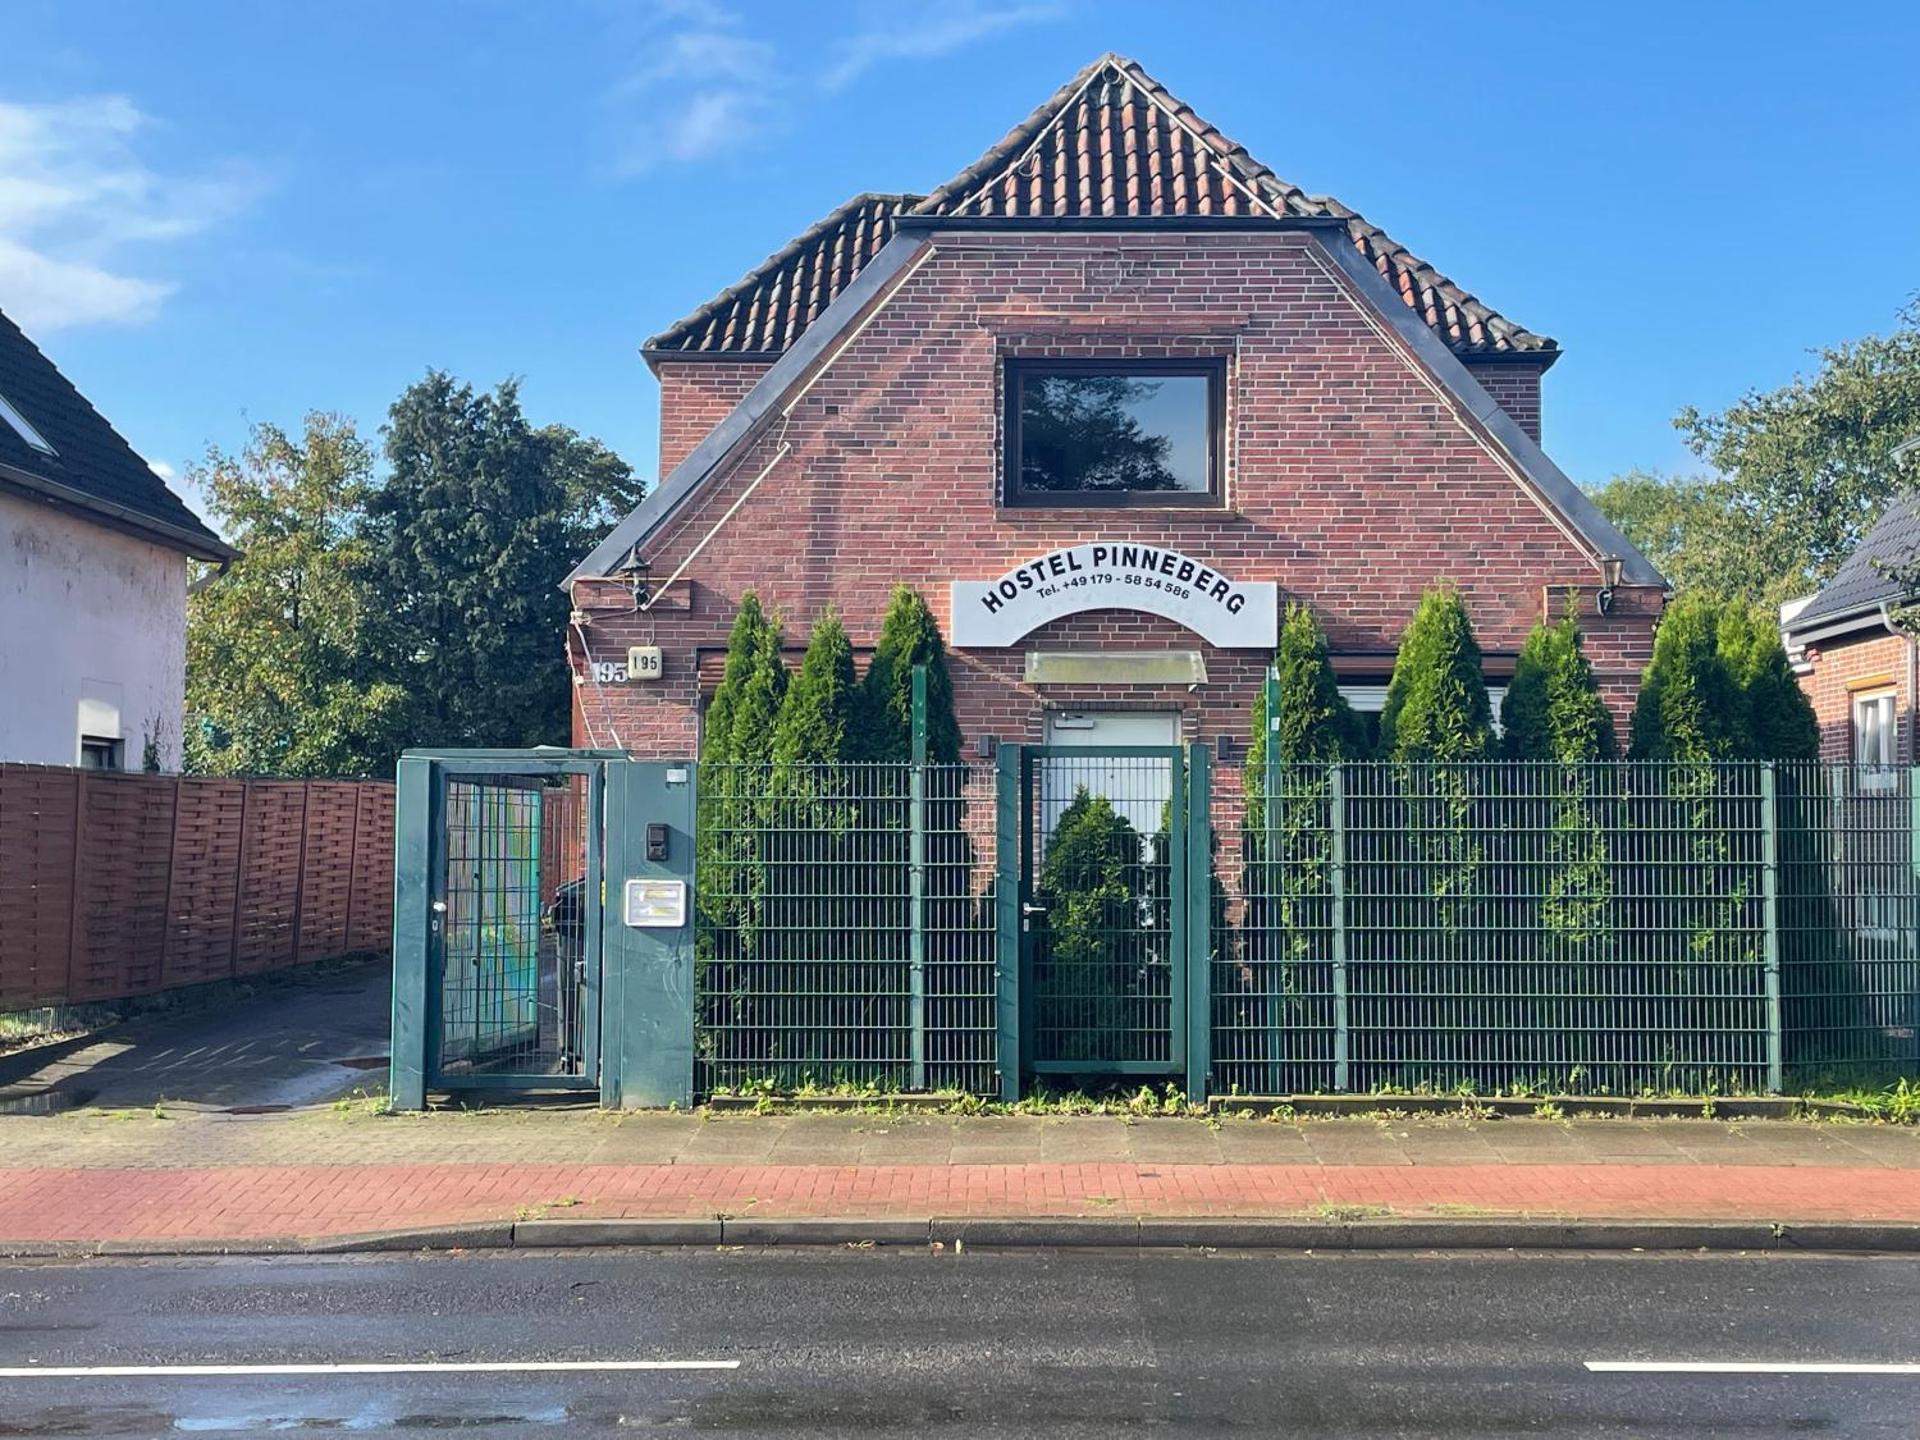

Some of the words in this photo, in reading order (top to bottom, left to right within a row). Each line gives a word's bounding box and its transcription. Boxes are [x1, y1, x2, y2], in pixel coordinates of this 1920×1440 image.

[981, 551, 1082, 614] HOSTEL
[1093, 546, 1245, 615] PINNEBERG
[1036, 584, 1060, 599] Tel.
[1062, 576, 1087, 591] +49
[1090, 573, 1112, 585] 179
[1124, 574, 1142, 585] 58
[1145, 577, 1162, 589] 54
[1164, 583, 1190, 600] 586
[634, 655, 658, 670] 195
